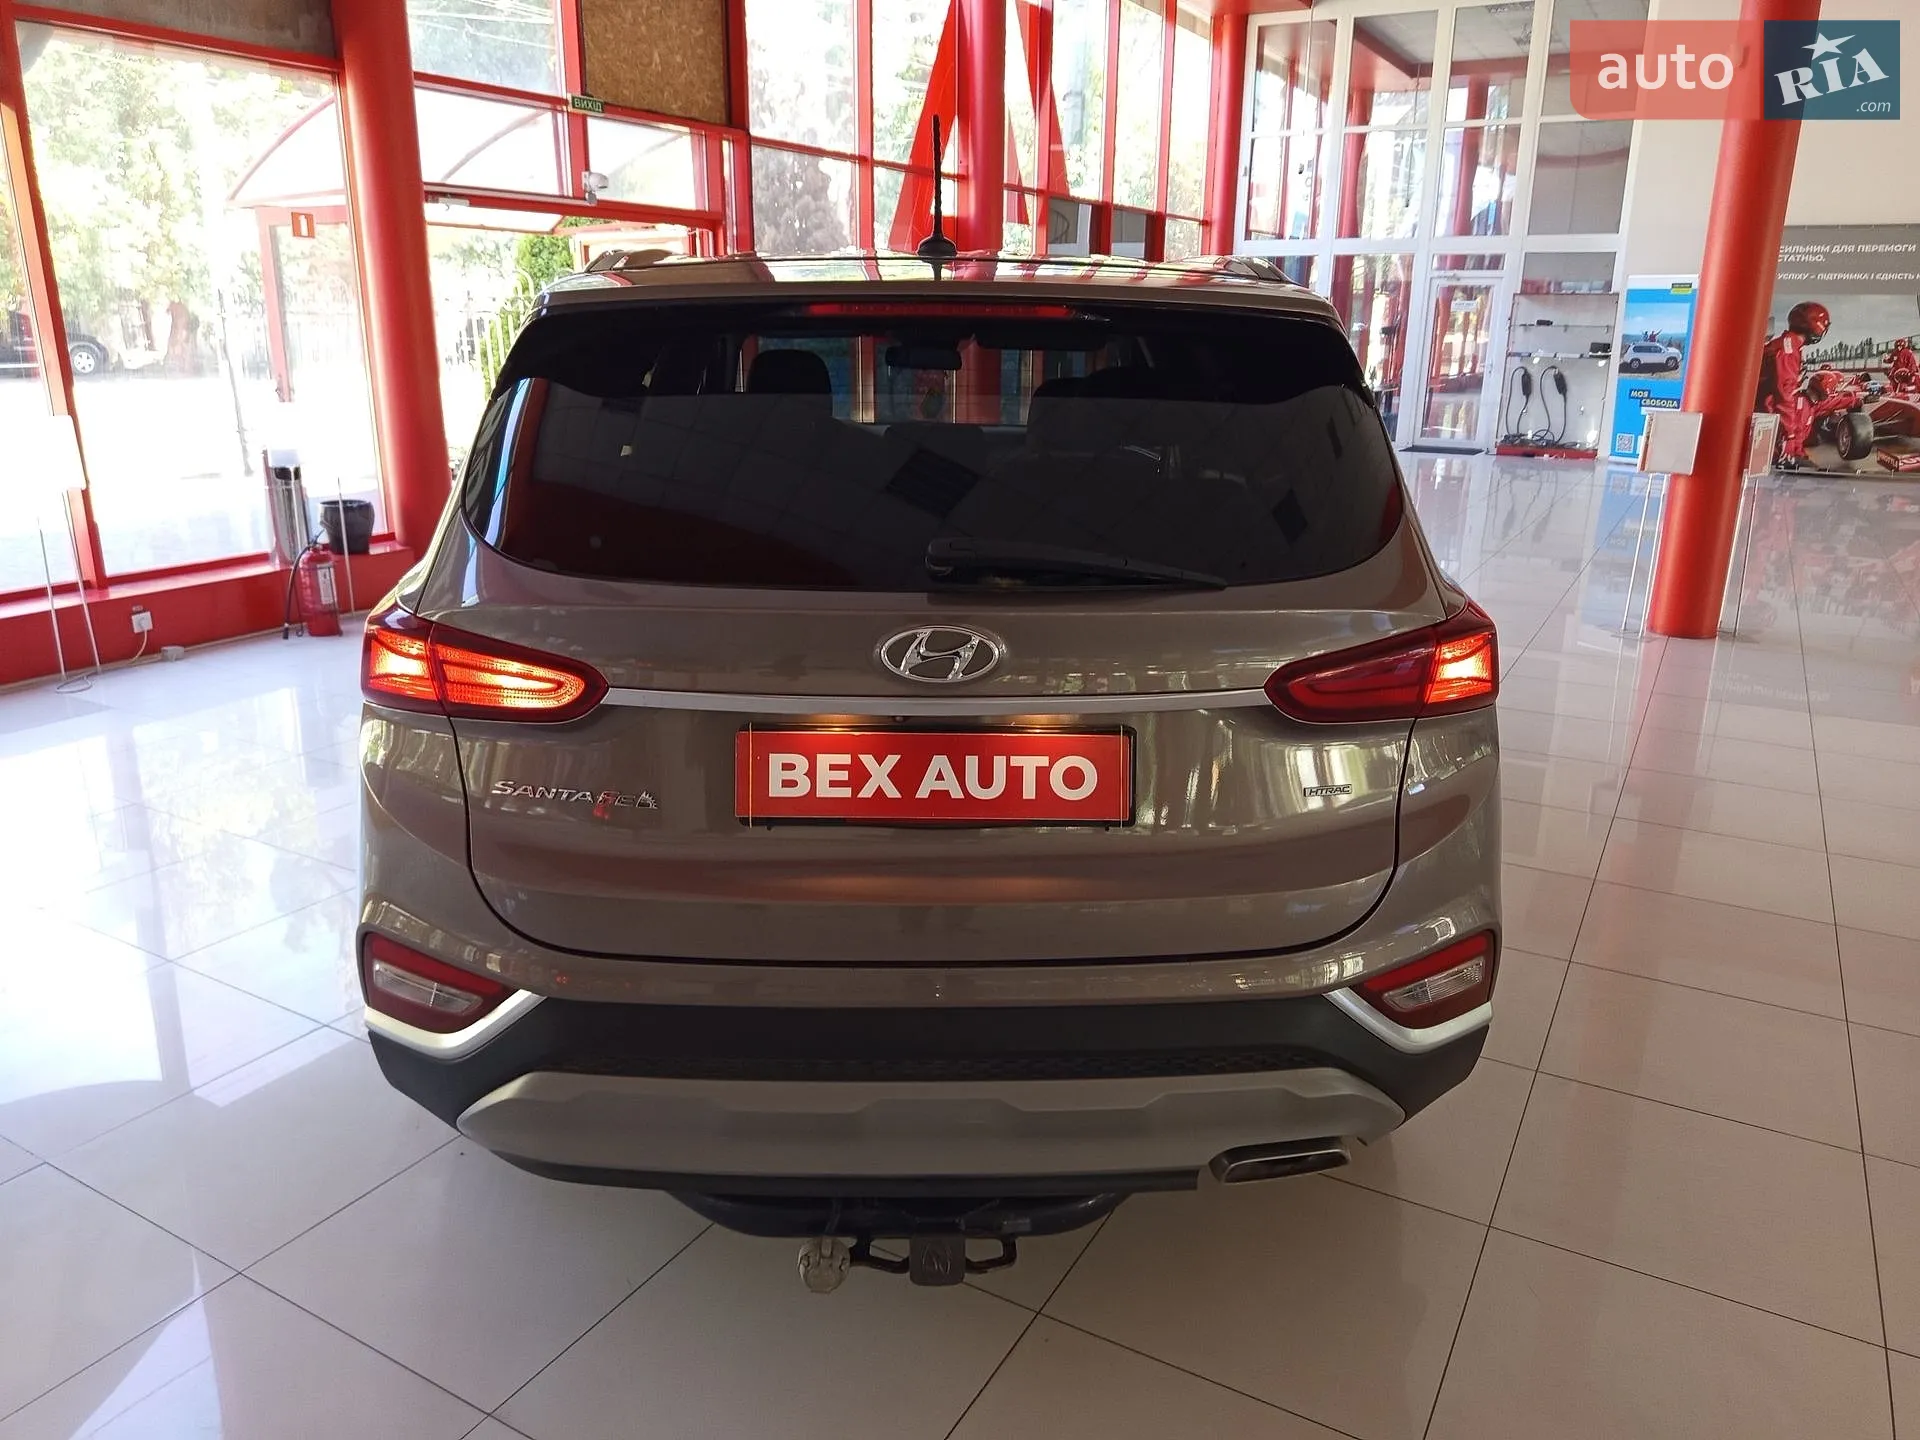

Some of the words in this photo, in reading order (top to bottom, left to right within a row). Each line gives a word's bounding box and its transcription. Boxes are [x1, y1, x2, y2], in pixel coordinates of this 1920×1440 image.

[574, 98, 602, 112] ВИХІД
[1831, 244, 1855, 254] ДЛЯ
[1857, 243, 1917, 253] ПЕРЕМОГИ
[1631, 390, 1649, 398] МОЯ
[1641, 399, 1678, 407] СВОБОДА
[768, 753, 902, 799] BEX
[915, 755, 1098, 801] AUTO
[1309, 786, 1350, 796] HTRAC
